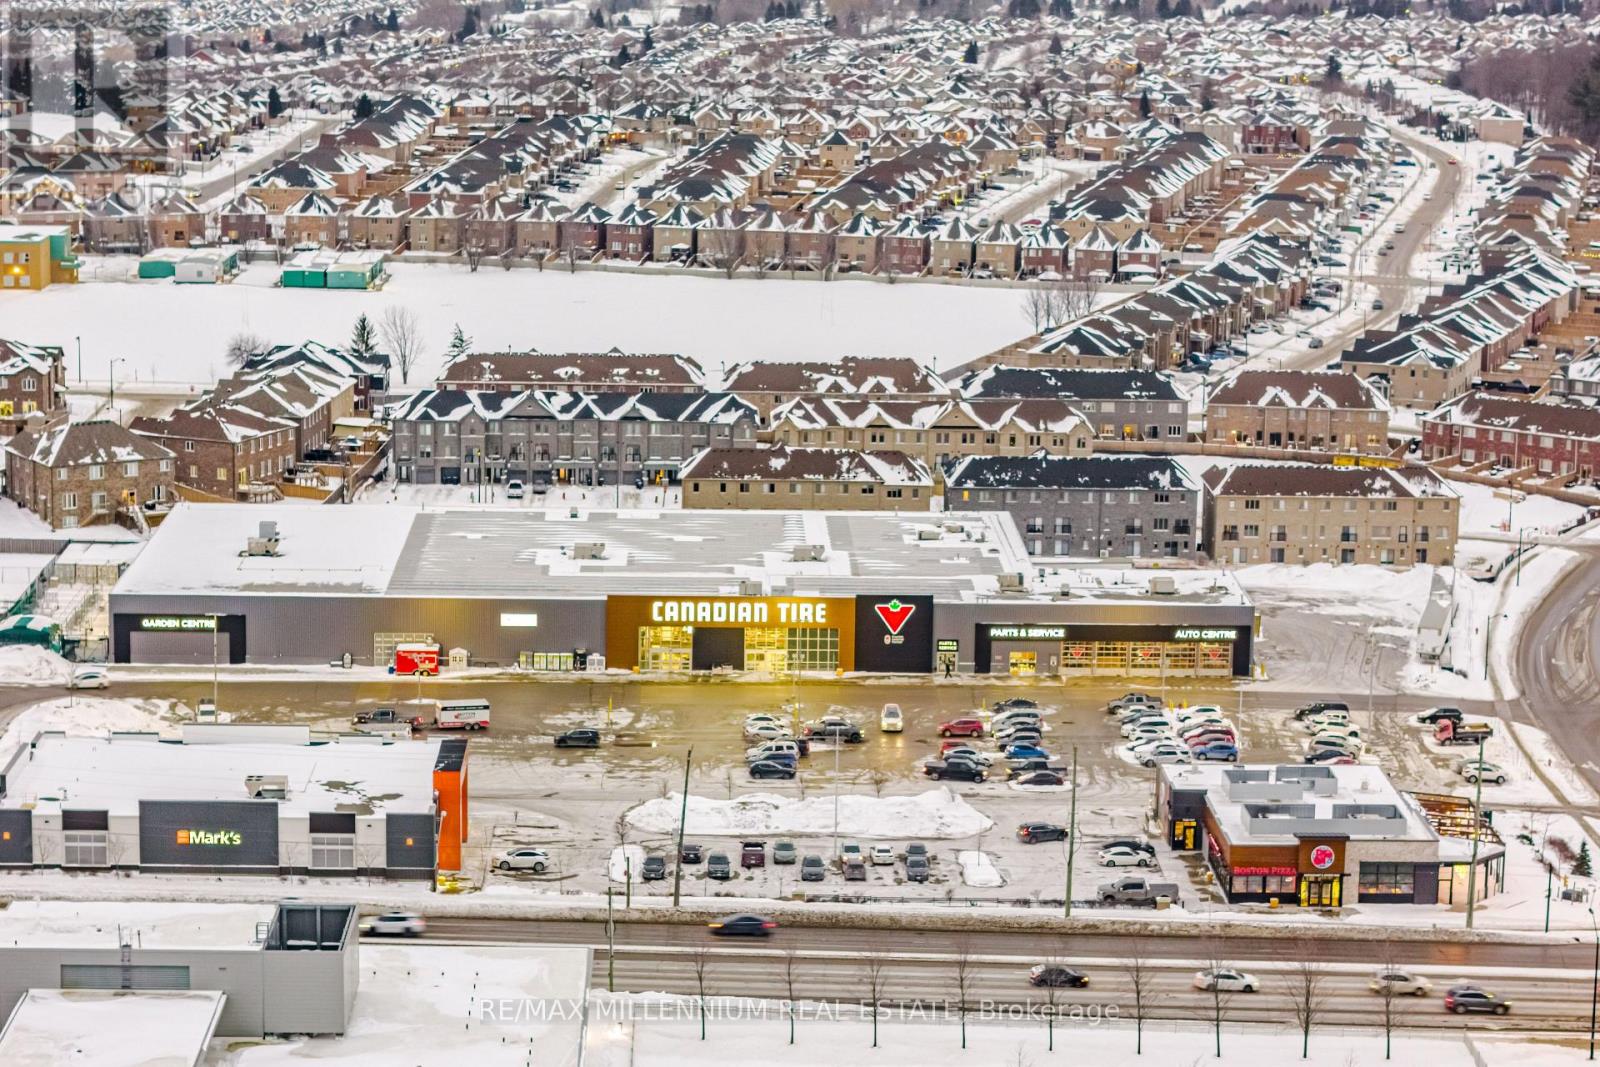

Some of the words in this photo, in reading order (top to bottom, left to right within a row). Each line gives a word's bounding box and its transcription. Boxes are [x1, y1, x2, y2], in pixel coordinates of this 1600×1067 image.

[652, 601, 768, 623] CANADIAN
[777, 602, 828, 623] TIRE
[142, 619, 180, 628] GARDEN
[181, 619, 216, 628] CENTRE
[990, 628, 1018, 638] PARTS
[1020, 628, 1027, 638] &
[1028, 629, 1065, 638] SERVICE
[1175, 630, 1199, 639] AUTO
[1202, 630, 1237, 639] CENTRE
[190, 831, 241, 844] Mark's
[1233, 866, 1269, 875] BOSTON
[1271, 867, 1297, 875] PIZZA
